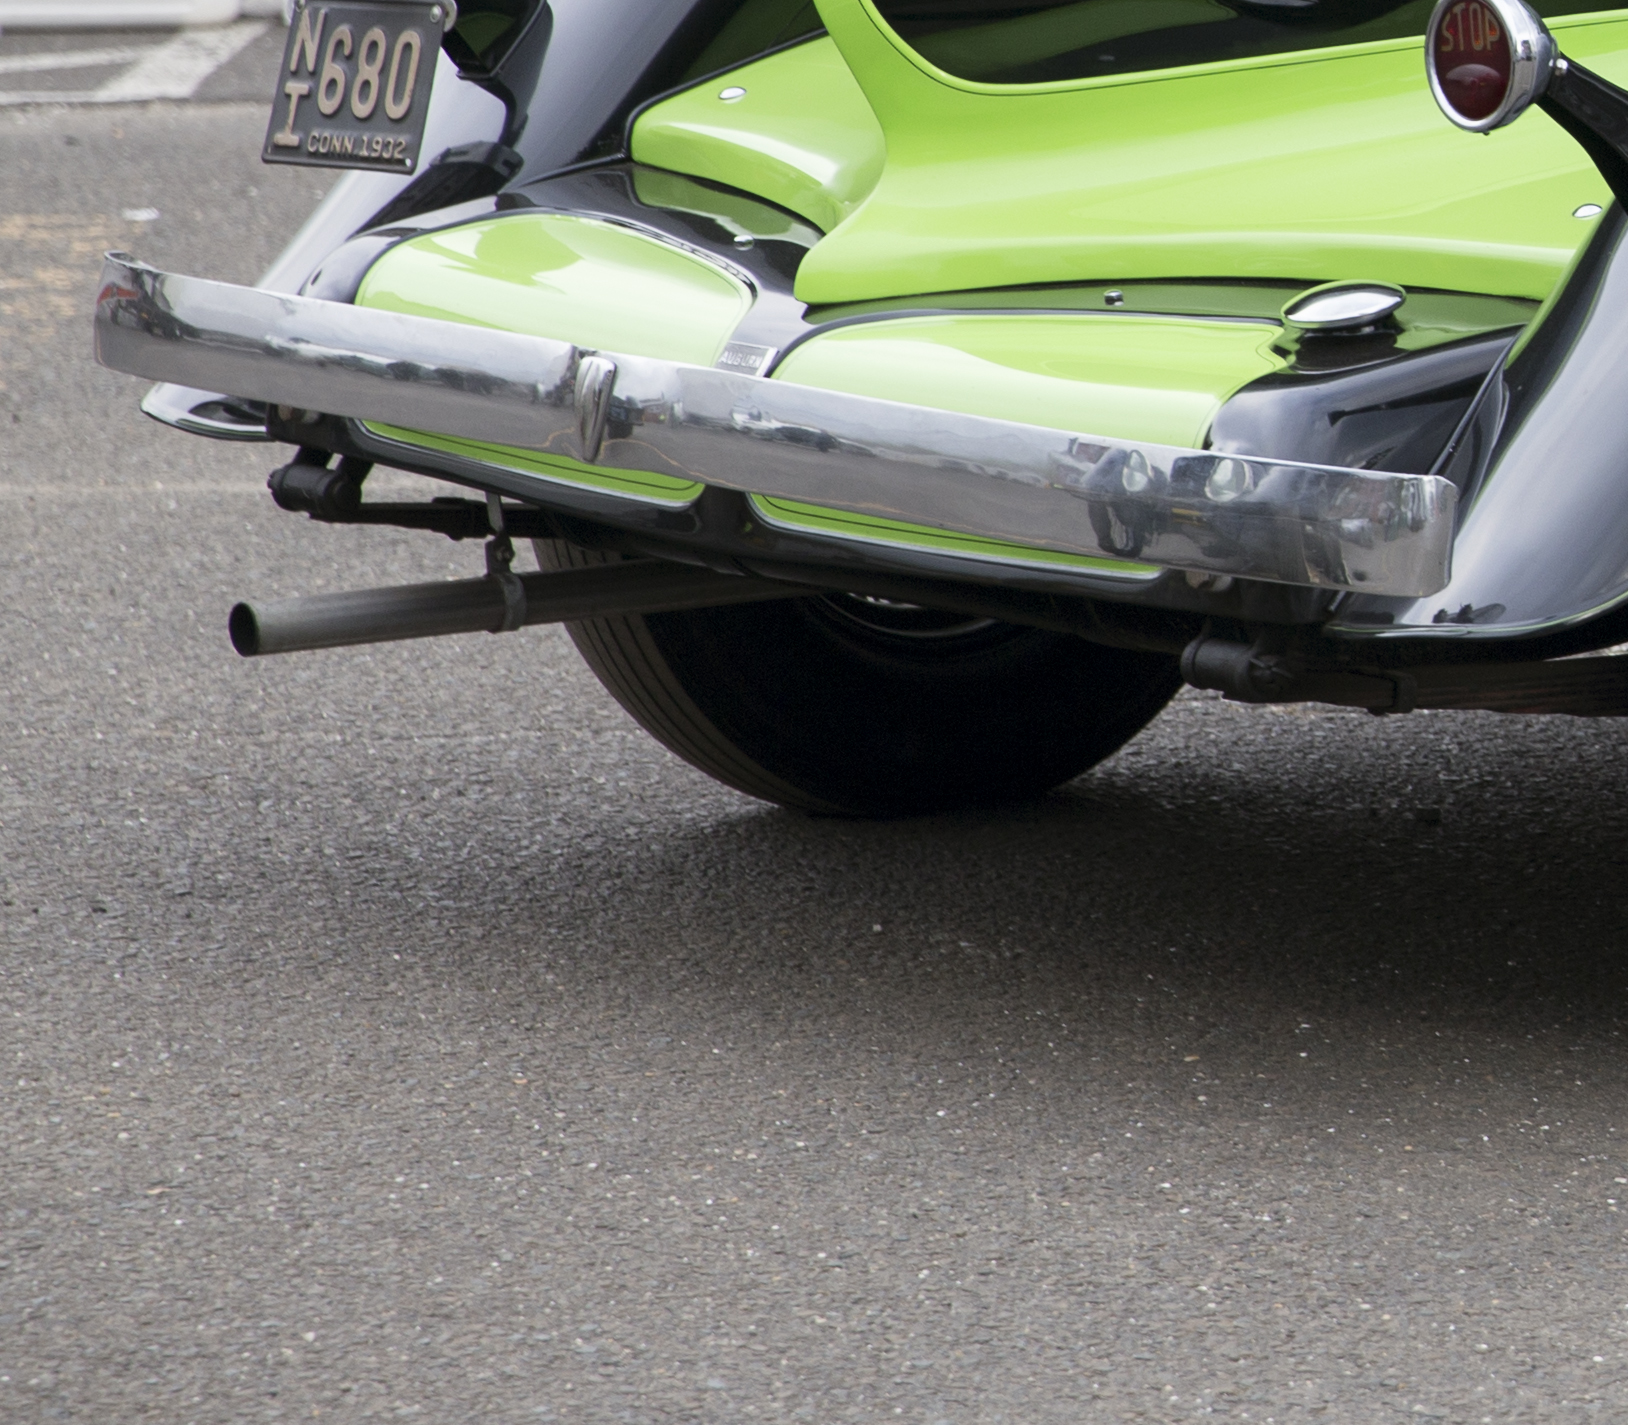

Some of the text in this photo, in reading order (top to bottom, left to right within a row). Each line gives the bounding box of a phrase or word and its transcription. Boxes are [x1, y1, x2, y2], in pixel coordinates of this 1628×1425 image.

[1441, 3, 1498, 51] STOP
[317, 26, 421, 120] 680
[359, 135, 406, 159] 1932
[719, 350, 763, 368] AUBURN
